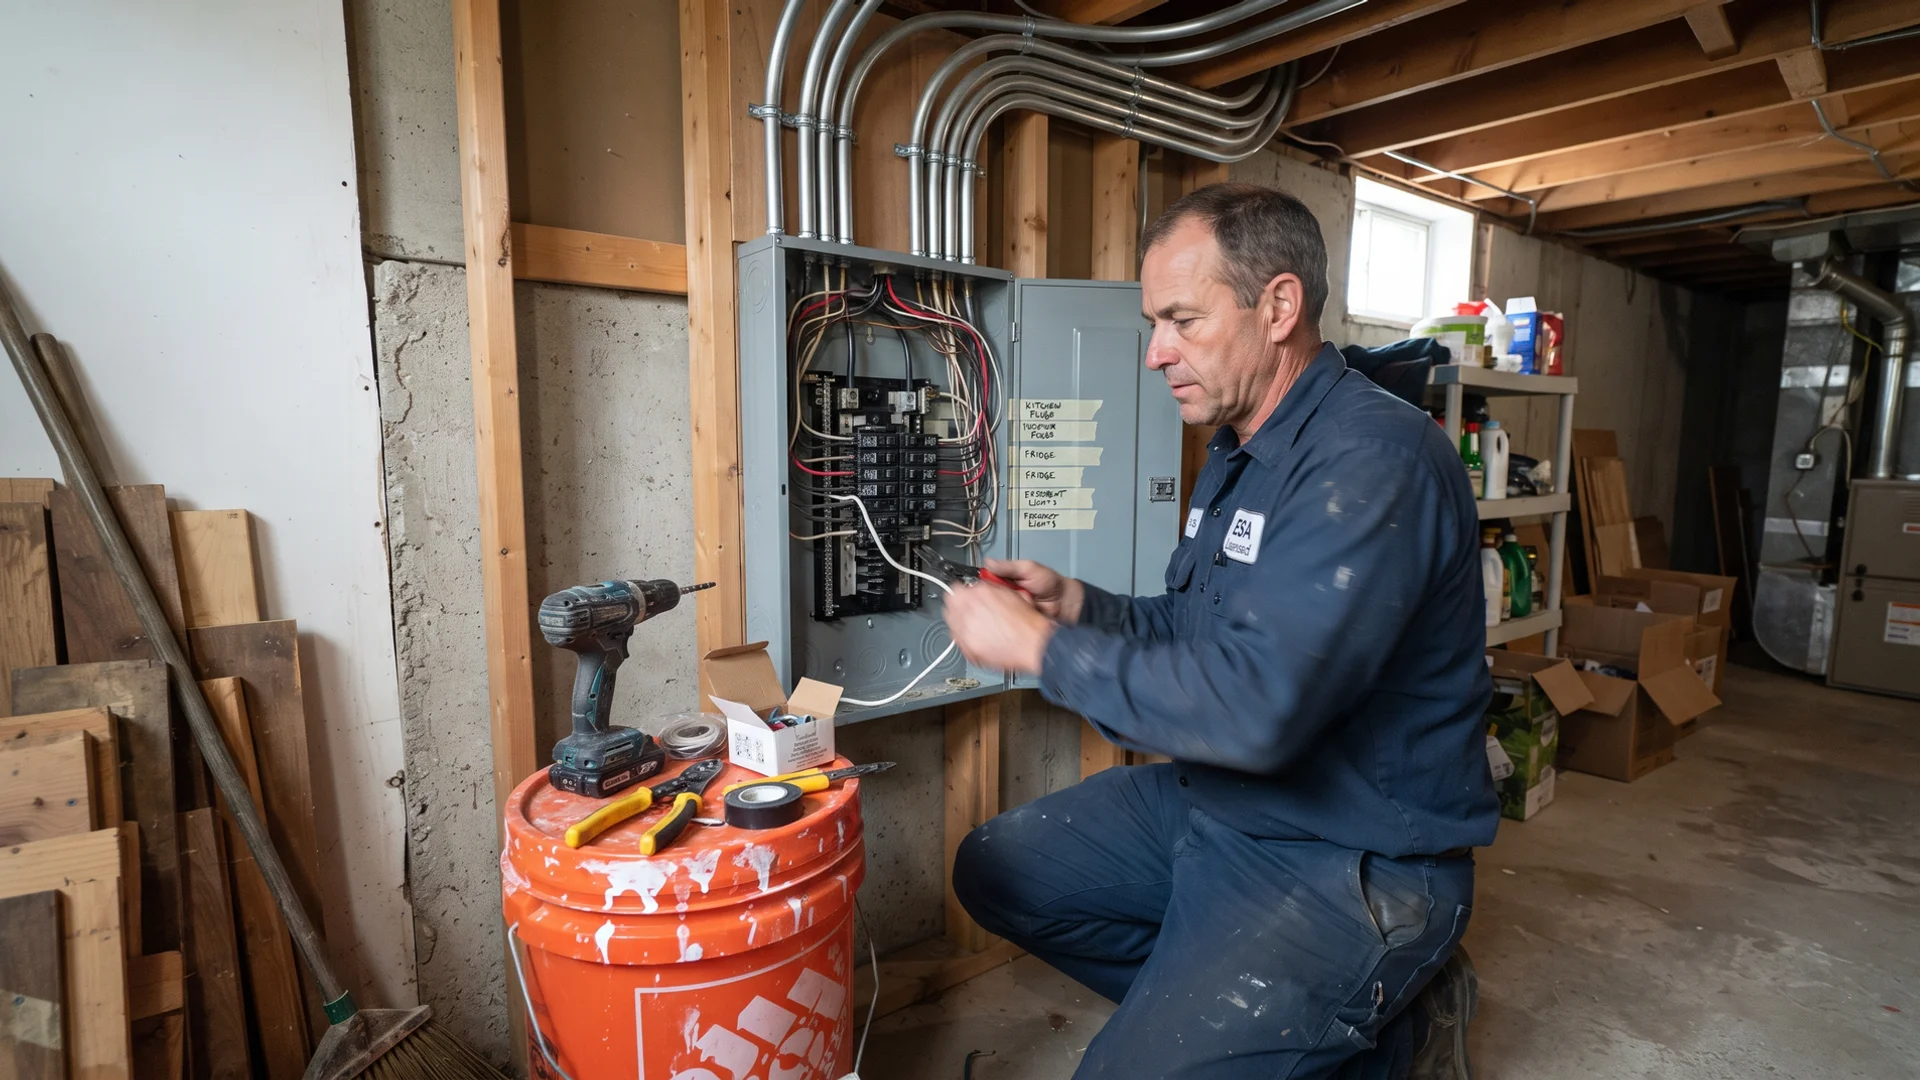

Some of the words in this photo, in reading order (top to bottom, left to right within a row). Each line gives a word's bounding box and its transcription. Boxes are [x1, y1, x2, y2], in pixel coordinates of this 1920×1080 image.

[1025, 402, 1061, 410] KITCHEN
[1025, 450, 1056, 460] FRIDGE
[1025, 470, 1056, 480] FRIDGE
[1233, 519, 1251, 539] ESA
